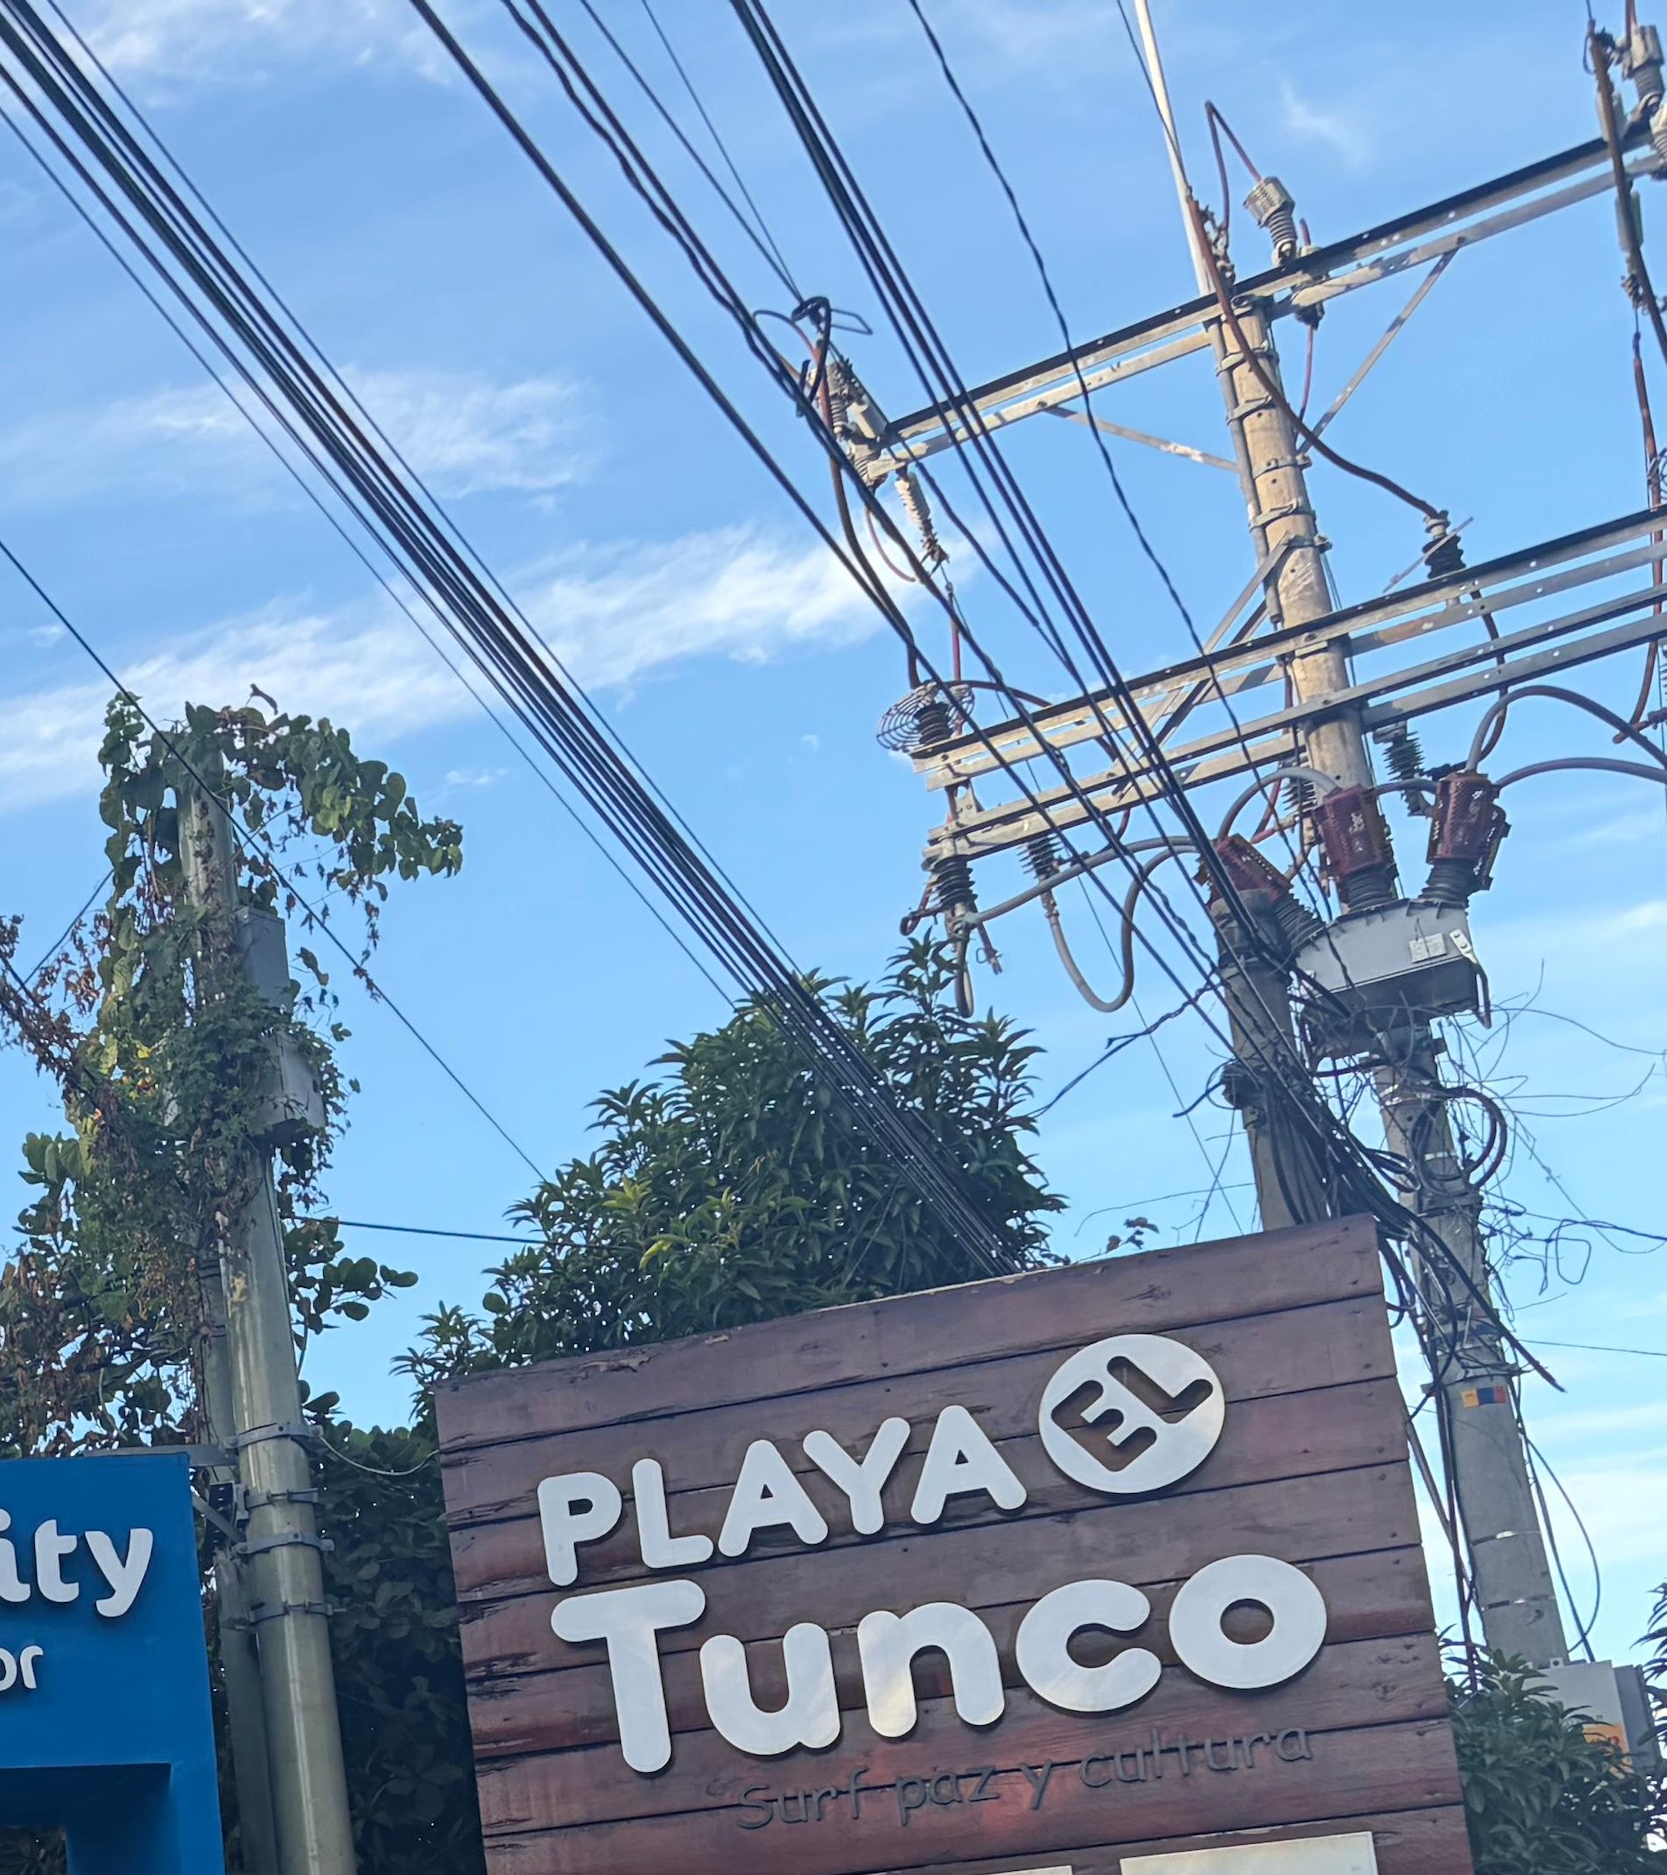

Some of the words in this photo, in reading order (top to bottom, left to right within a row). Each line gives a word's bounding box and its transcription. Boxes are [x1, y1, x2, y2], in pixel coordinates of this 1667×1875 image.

[538, 1405, 1027, 1587] PLAYA
[1050, 1355, 1214, 1475] EL
[550, 1553, 1328, 1774] Tunco
[736, 1766, 870, 1831] Surf
[894, 1765, 1001, 1826] paz
[1018, 1755, 1054, 1811] y
[1078, 1724, 1314, 1789] cultura
